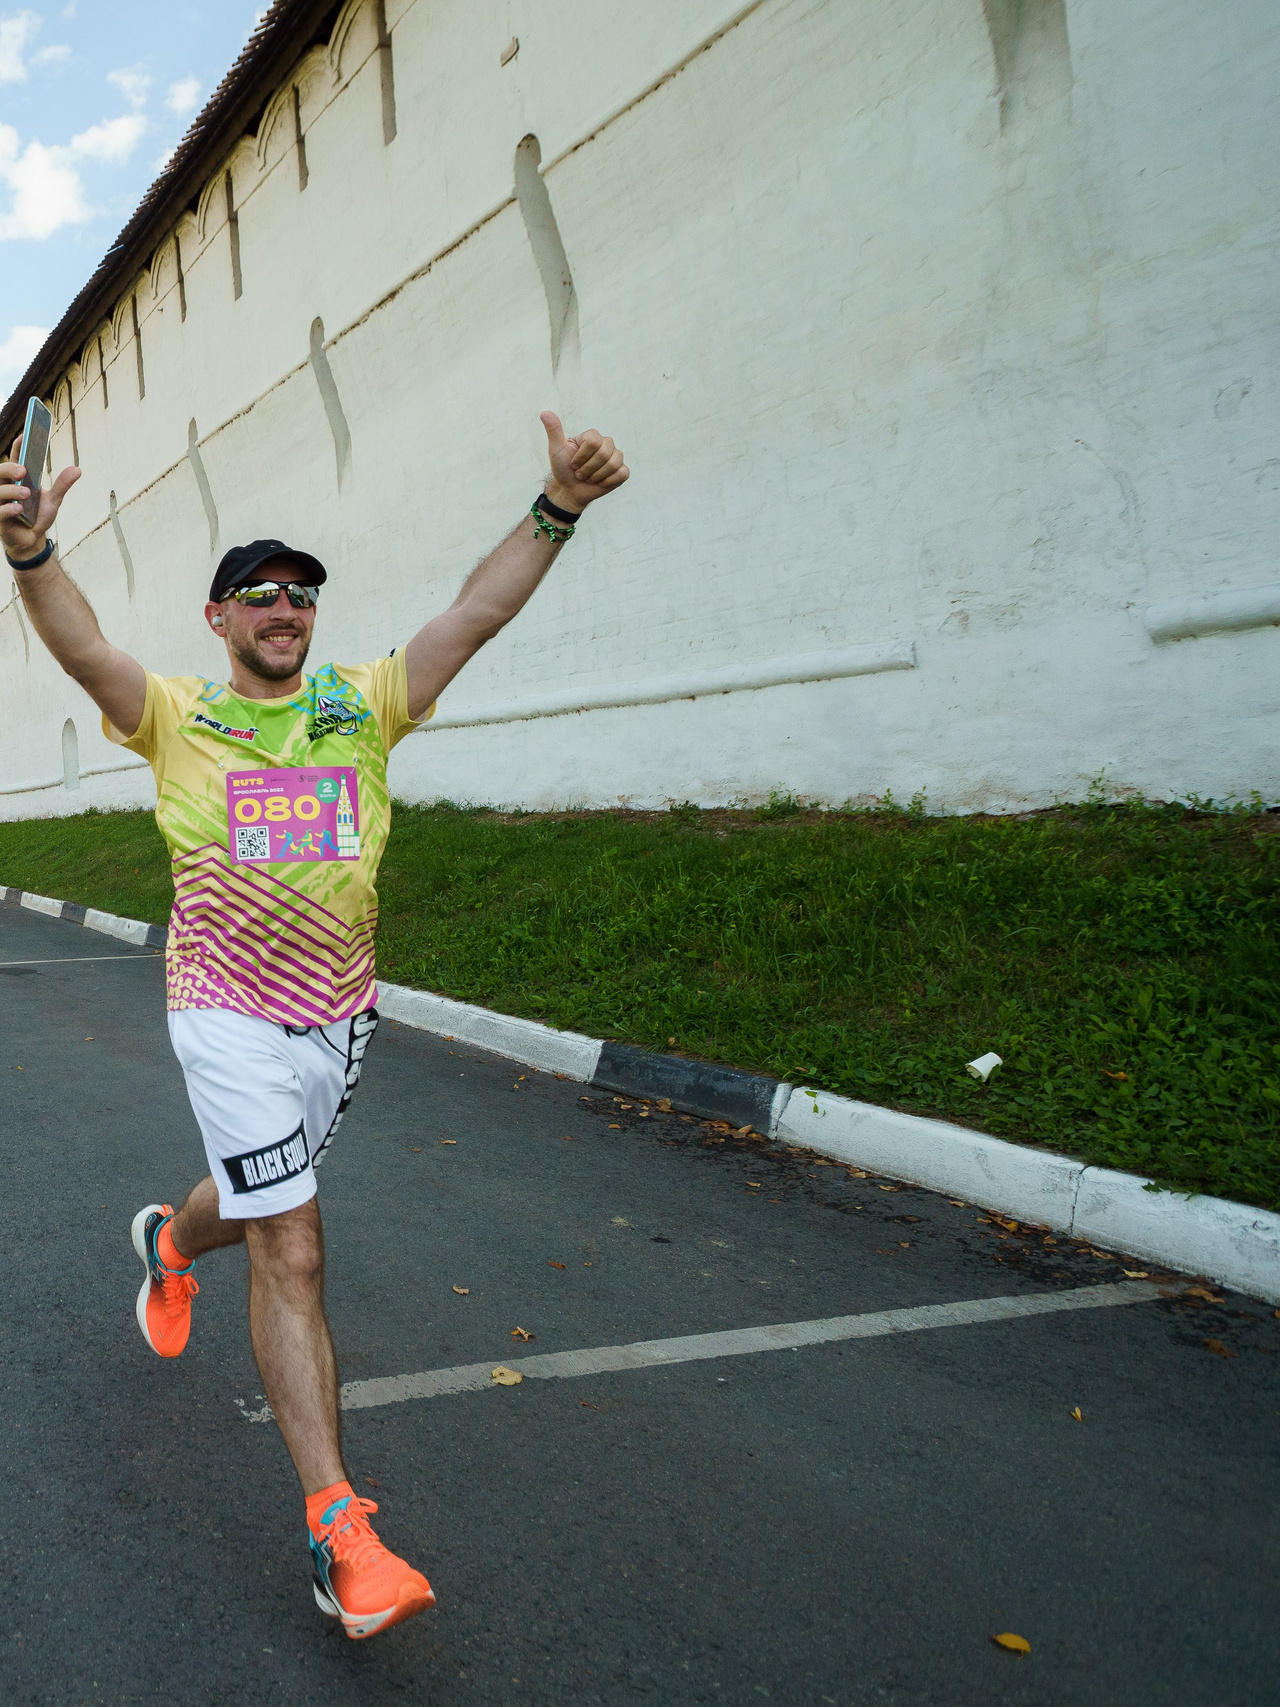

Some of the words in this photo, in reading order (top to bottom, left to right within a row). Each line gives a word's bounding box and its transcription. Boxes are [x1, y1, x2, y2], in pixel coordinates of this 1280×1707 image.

[232, 778, 264, 787] RUTS
[322, 782, 333, 793] 2
[234, 795, 321, 823] 080
[241, 1147, 288, 1187] BLACK
